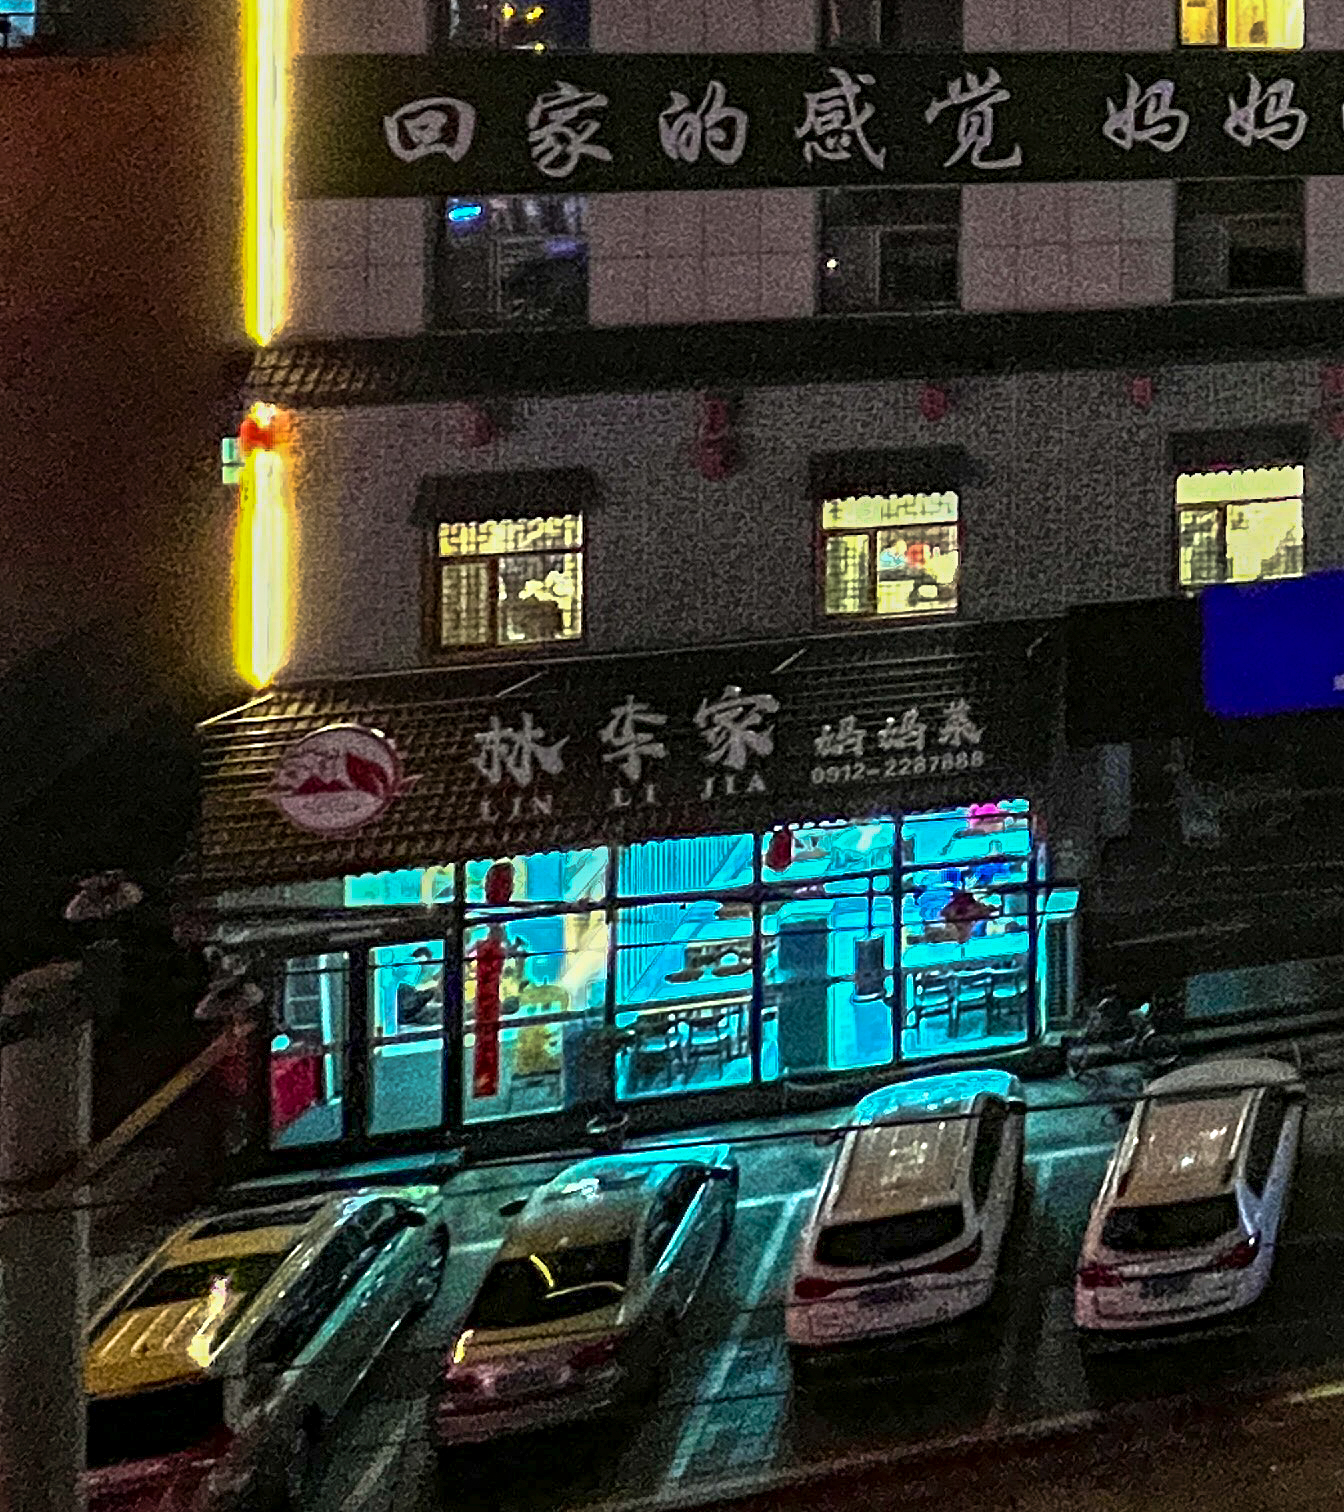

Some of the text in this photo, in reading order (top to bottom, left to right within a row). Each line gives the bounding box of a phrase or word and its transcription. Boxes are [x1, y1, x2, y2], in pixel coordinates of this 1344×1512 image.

[383, 66, 1024, 178] 回家的感觉
